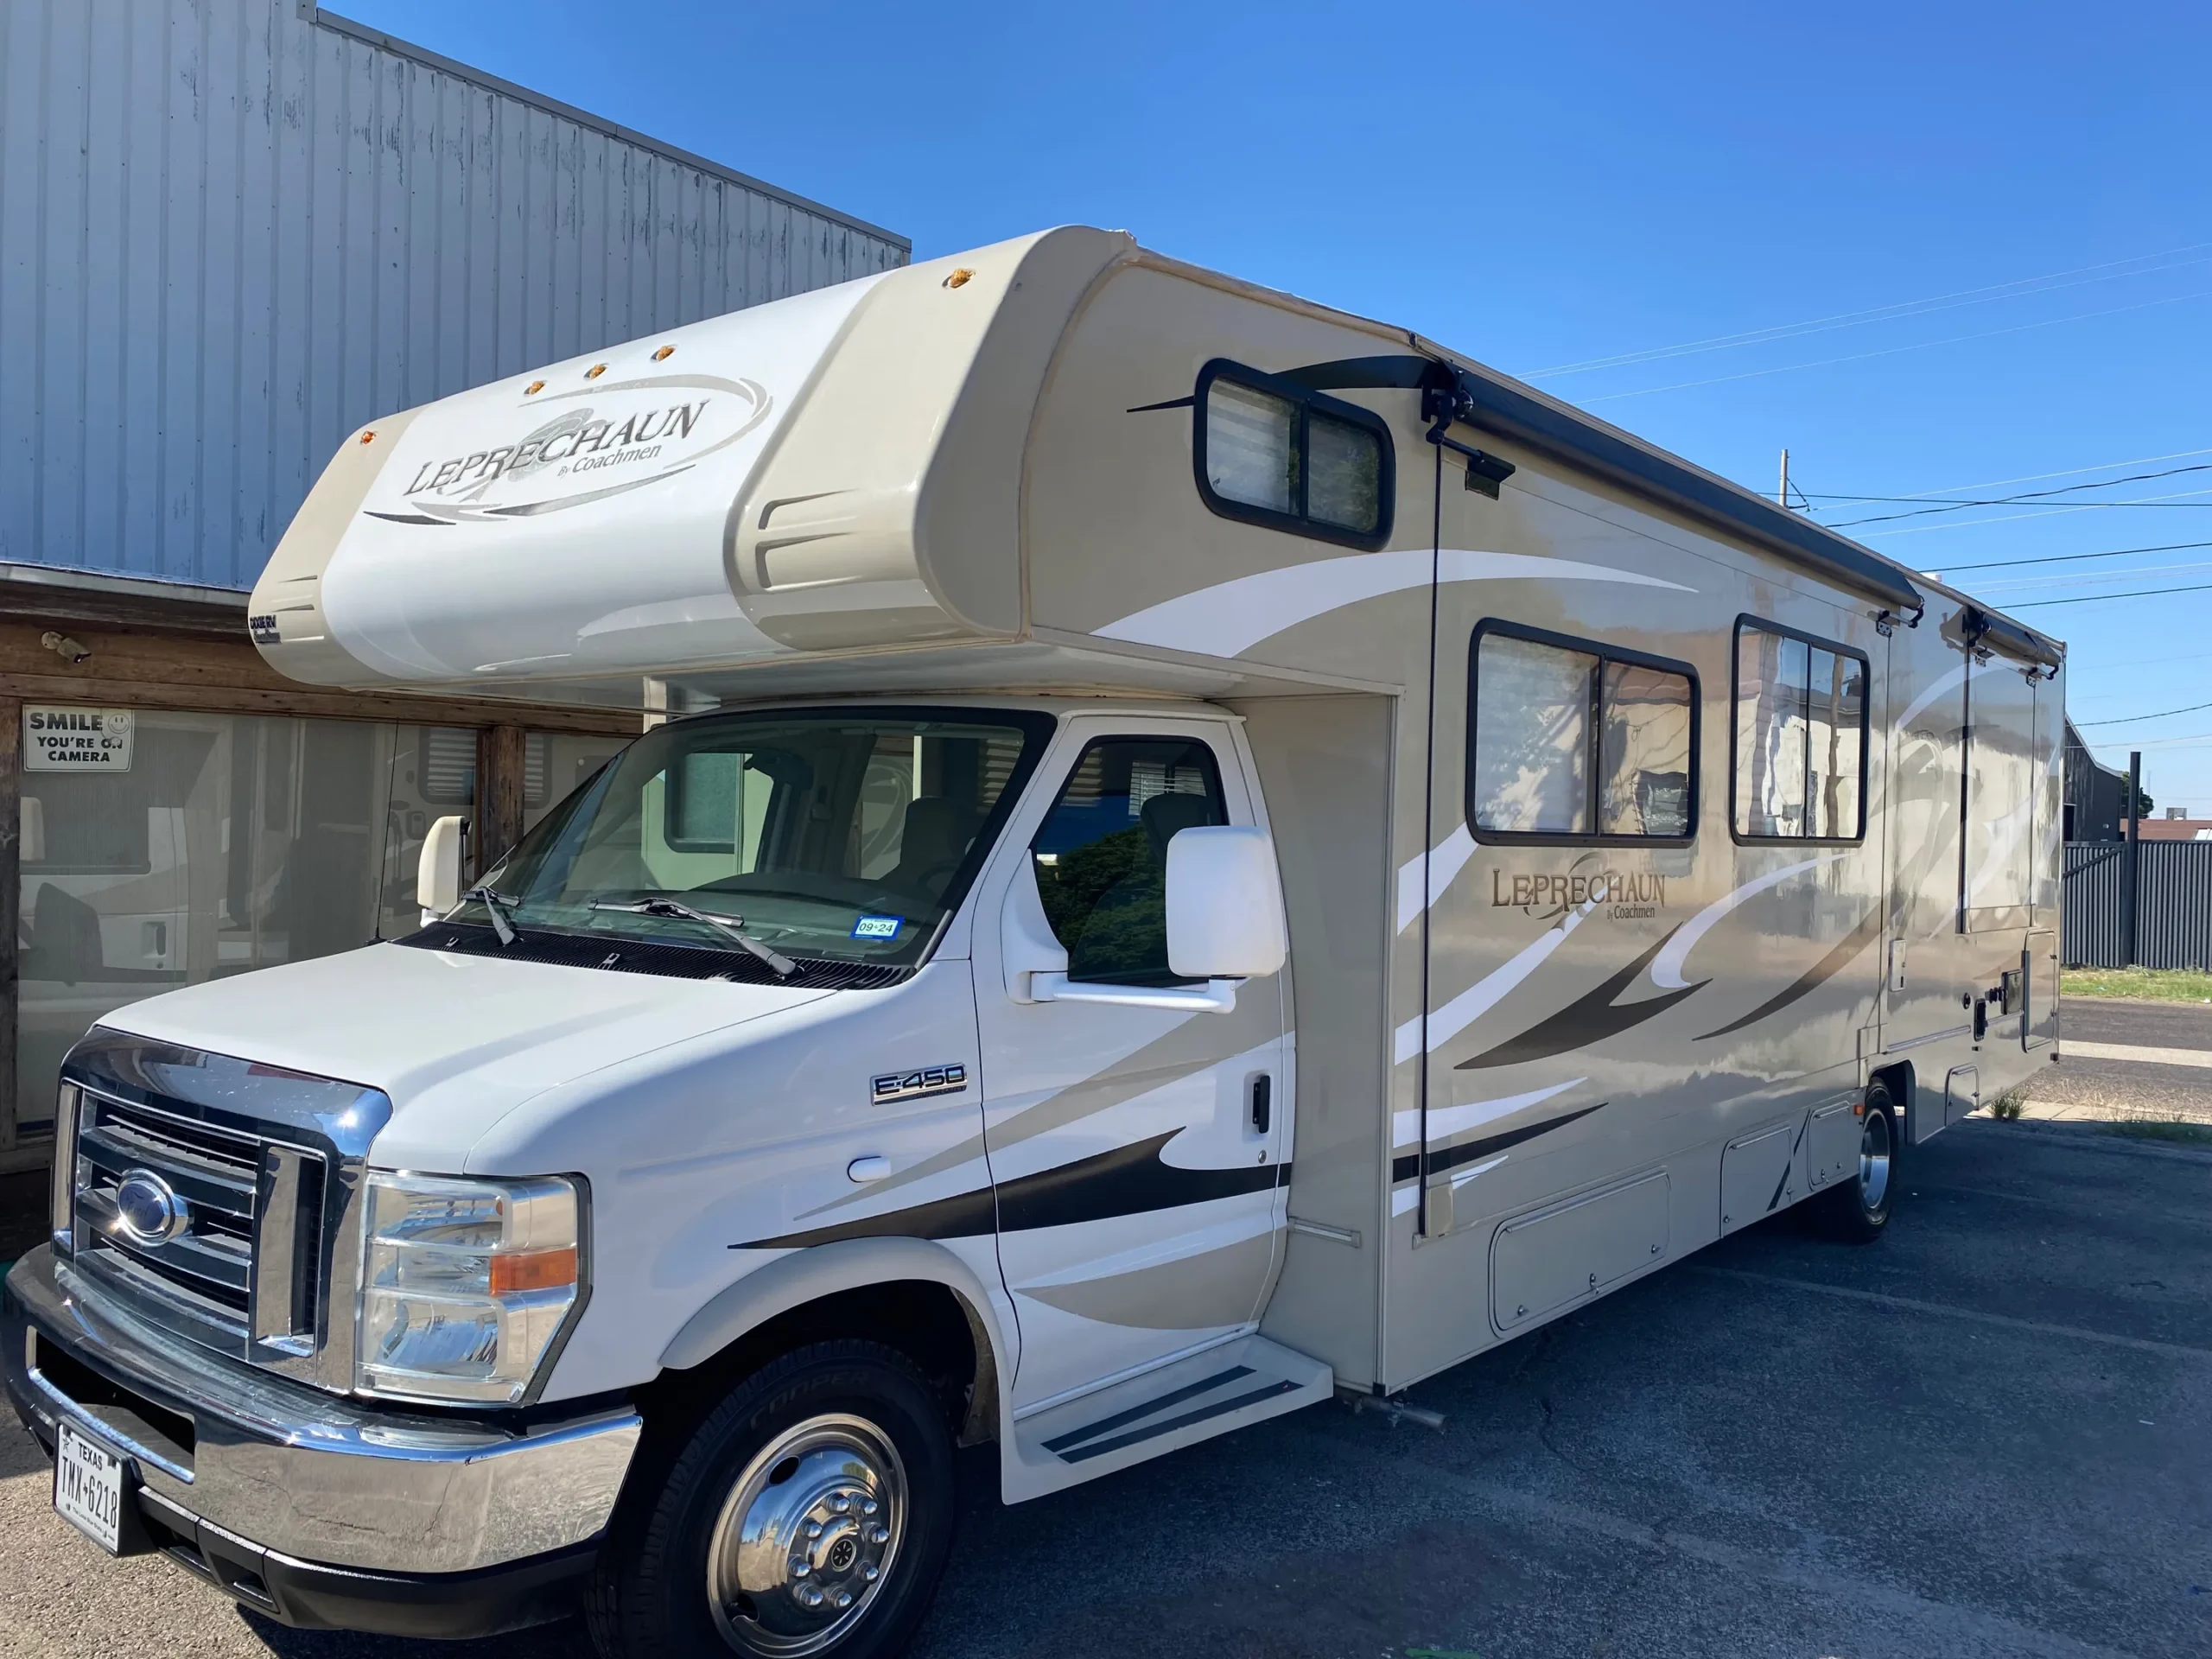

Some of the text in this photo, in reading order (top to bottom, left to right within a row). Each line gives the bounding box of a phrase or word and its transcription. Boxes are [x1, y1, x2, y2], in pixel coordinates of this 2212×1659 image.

[402, 398, 711, 497] LEPRECHAUN
[572, 445, 663, 474] Coachmen
[266, 614, 276, 629] RV
[29, 712, 103, 731] SMILE
[37, 736, 94, 748] YOU'RE
[48, 751, 110, 762] CAMERA
[1491, 868, 1666, 912] LEPRECHAUN
[1614, 904, 1656, 918] Coachmen
[874, 1065, 965, 1096] E-450
[78, 1441, 103, 1471] TEXAS
